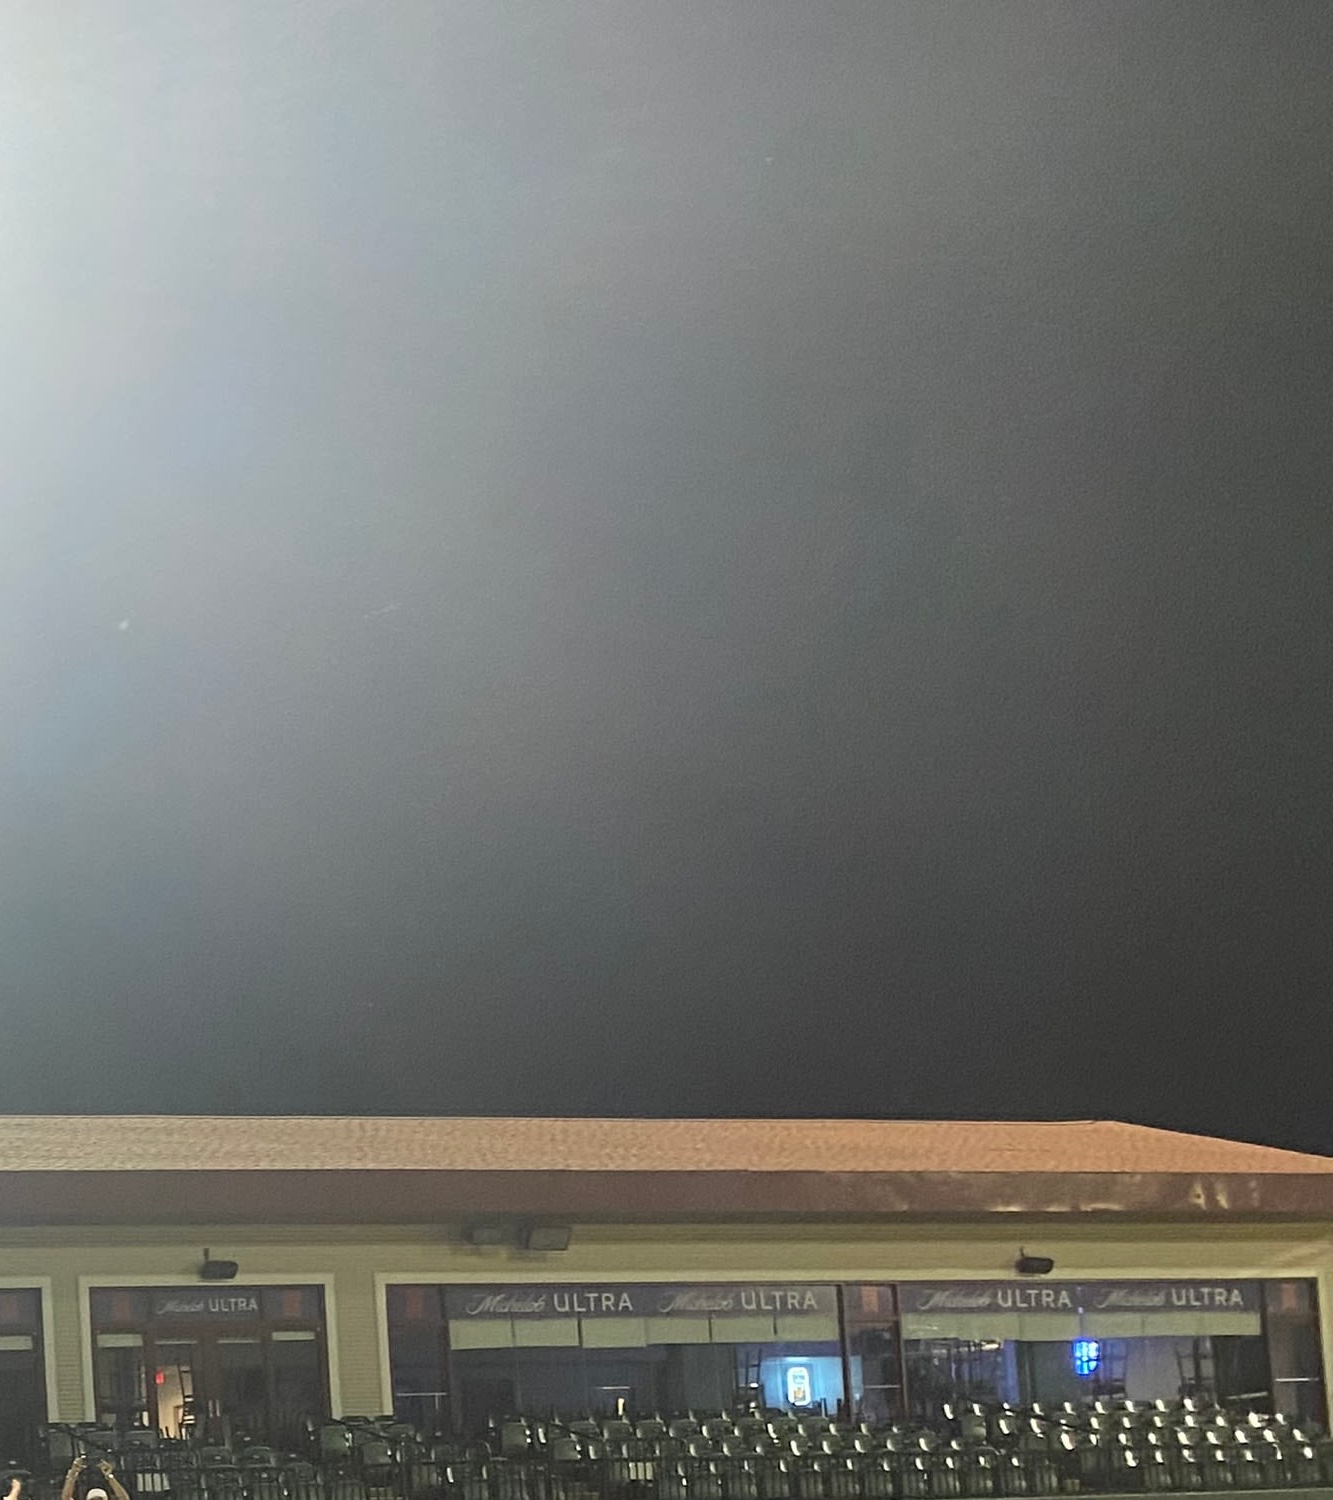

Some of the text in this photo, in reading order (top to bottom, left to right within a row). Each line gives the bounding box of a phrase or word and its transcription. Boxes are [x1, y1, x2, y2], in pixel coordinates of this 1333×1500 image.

[208, 1298, 259, 1313] ULTRA
[553, 1292, 634, 1313] ULTRA
[740, 1290, 818, 1311] ULTRA
[997, 1290, 1073, 1310] ULTRA
[1171, 1287, 1244, 1307] ULTRA
